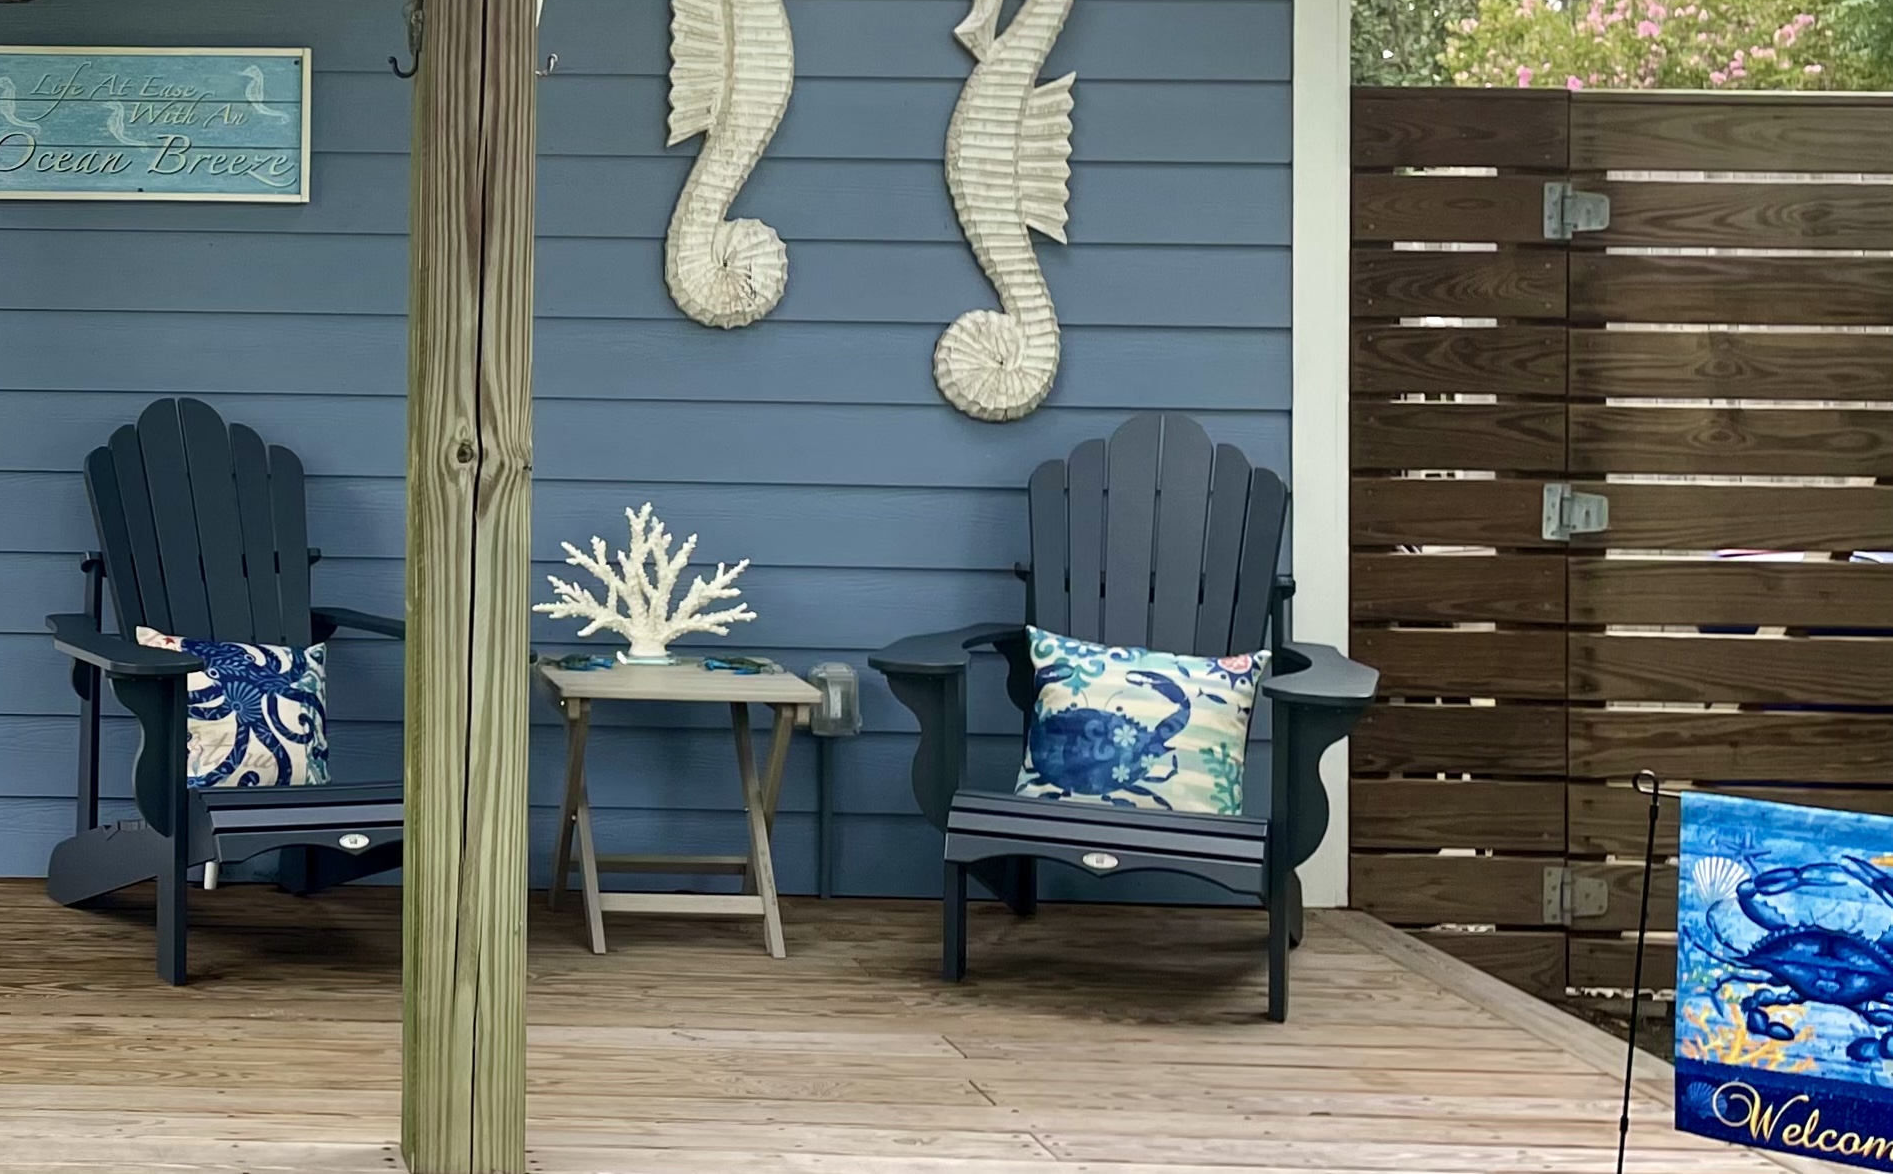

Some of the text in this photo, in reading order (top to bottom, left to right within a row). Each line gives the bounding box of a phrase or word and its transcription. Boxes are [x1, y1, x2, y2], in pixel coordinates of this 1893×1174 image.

[27, 61, 198, 122] Life At Ease
[128, 91, 250, 128] With An
[147, 133, 297, 187] Breeze
